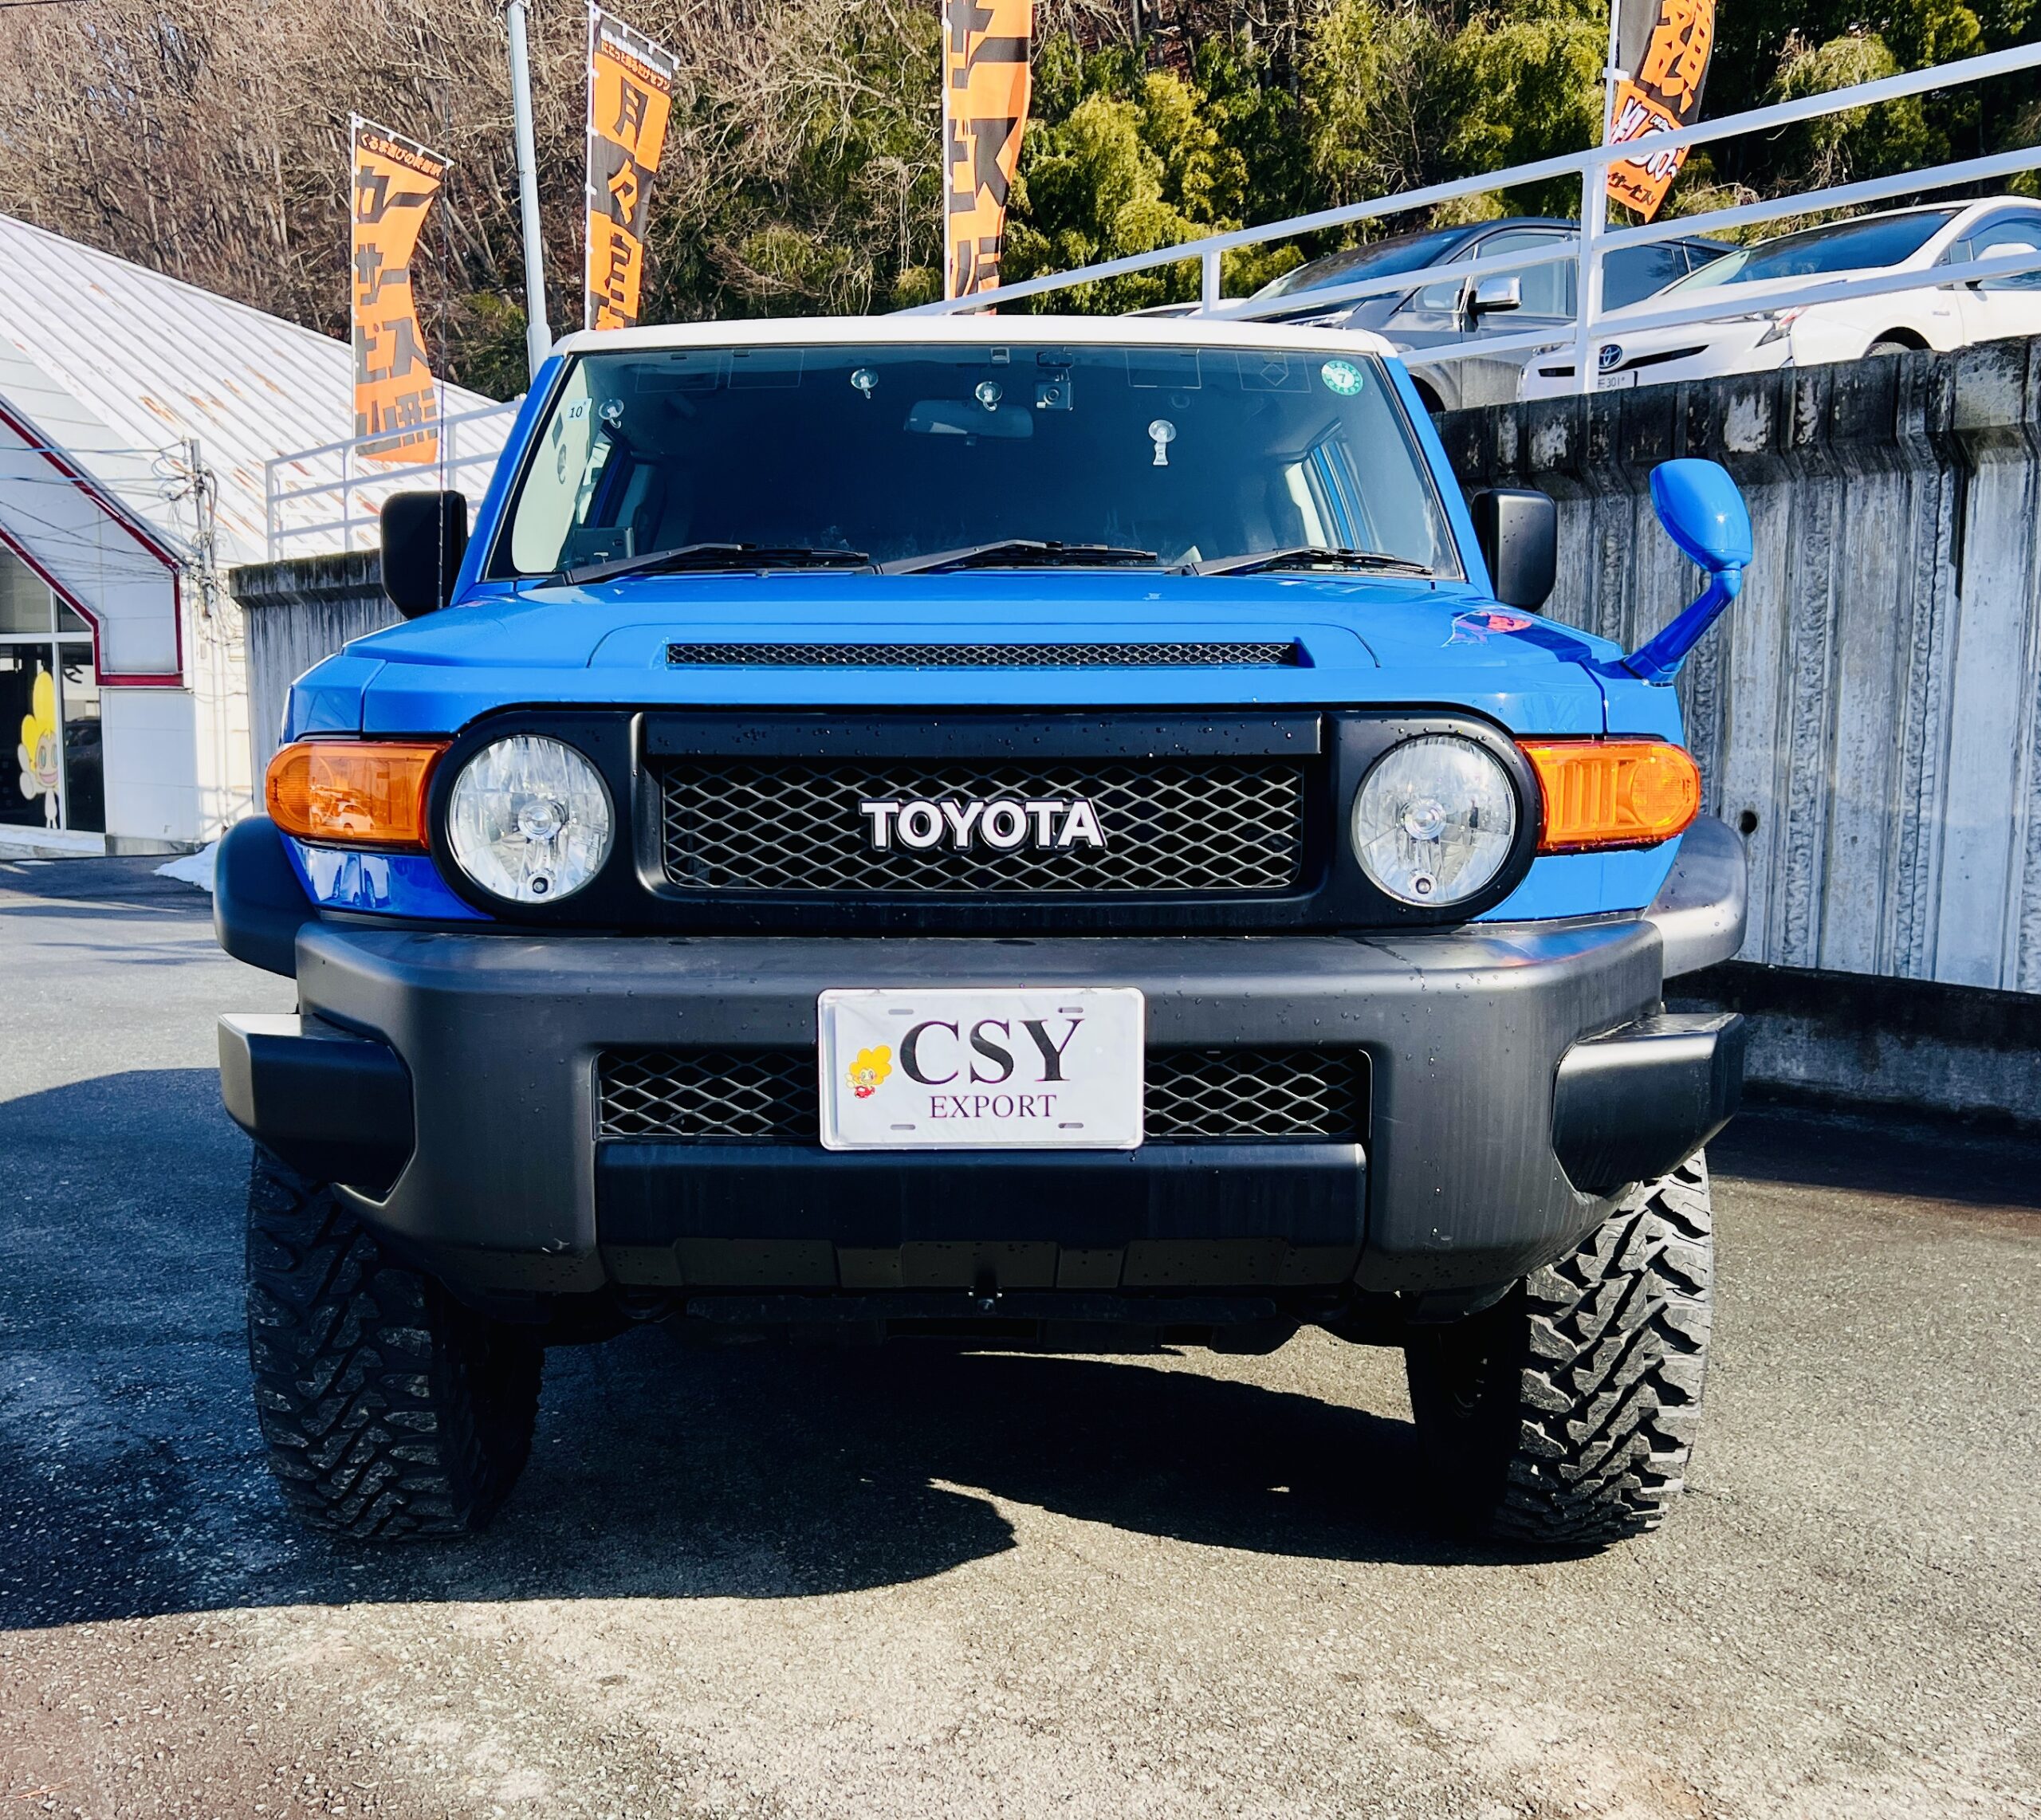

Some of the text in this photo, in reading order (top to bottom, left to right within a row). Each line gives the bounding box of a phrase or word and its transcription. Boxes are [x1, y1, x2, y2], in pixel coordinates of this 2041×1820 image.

[568, 406, 583, 419] 10
[859, 798, 1107, 851] TOYOTA
[899, 1018, 1085, 1086] CSY
[929, 1094, 1058, 1118] EXPORT
